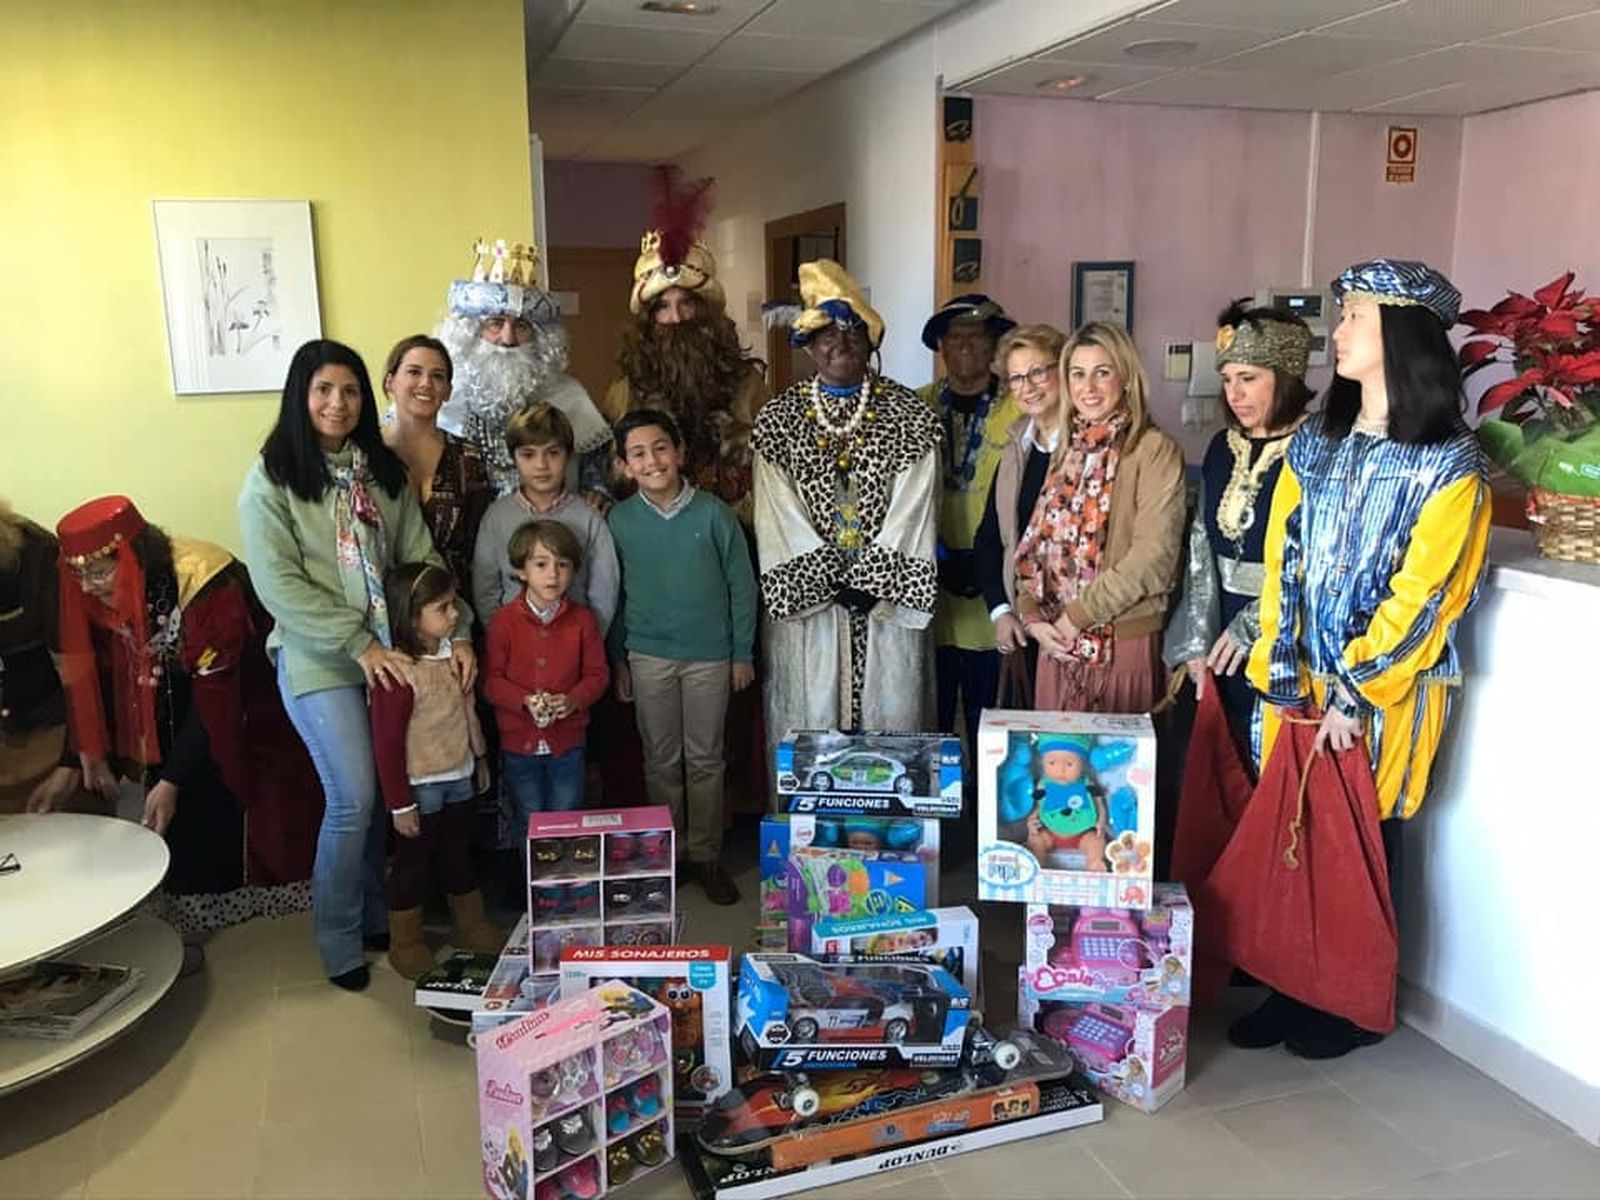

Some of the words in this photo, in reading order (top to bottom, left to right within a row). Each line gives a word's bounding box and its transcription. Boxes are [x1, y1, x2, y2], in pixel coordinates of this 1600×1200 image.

[797, 796, 818, 812] 5
[818, 798, 890, 809] FUNCIONES
[573, 949, 605, 959] MIS
[611, 949, 710, 959] SONAJEROS
[782, 1050, 807, 1067] 5
[807, 1050, 888, 1061] FUNCIONES
[878, 1144, 950, 1170] DUNLOP
